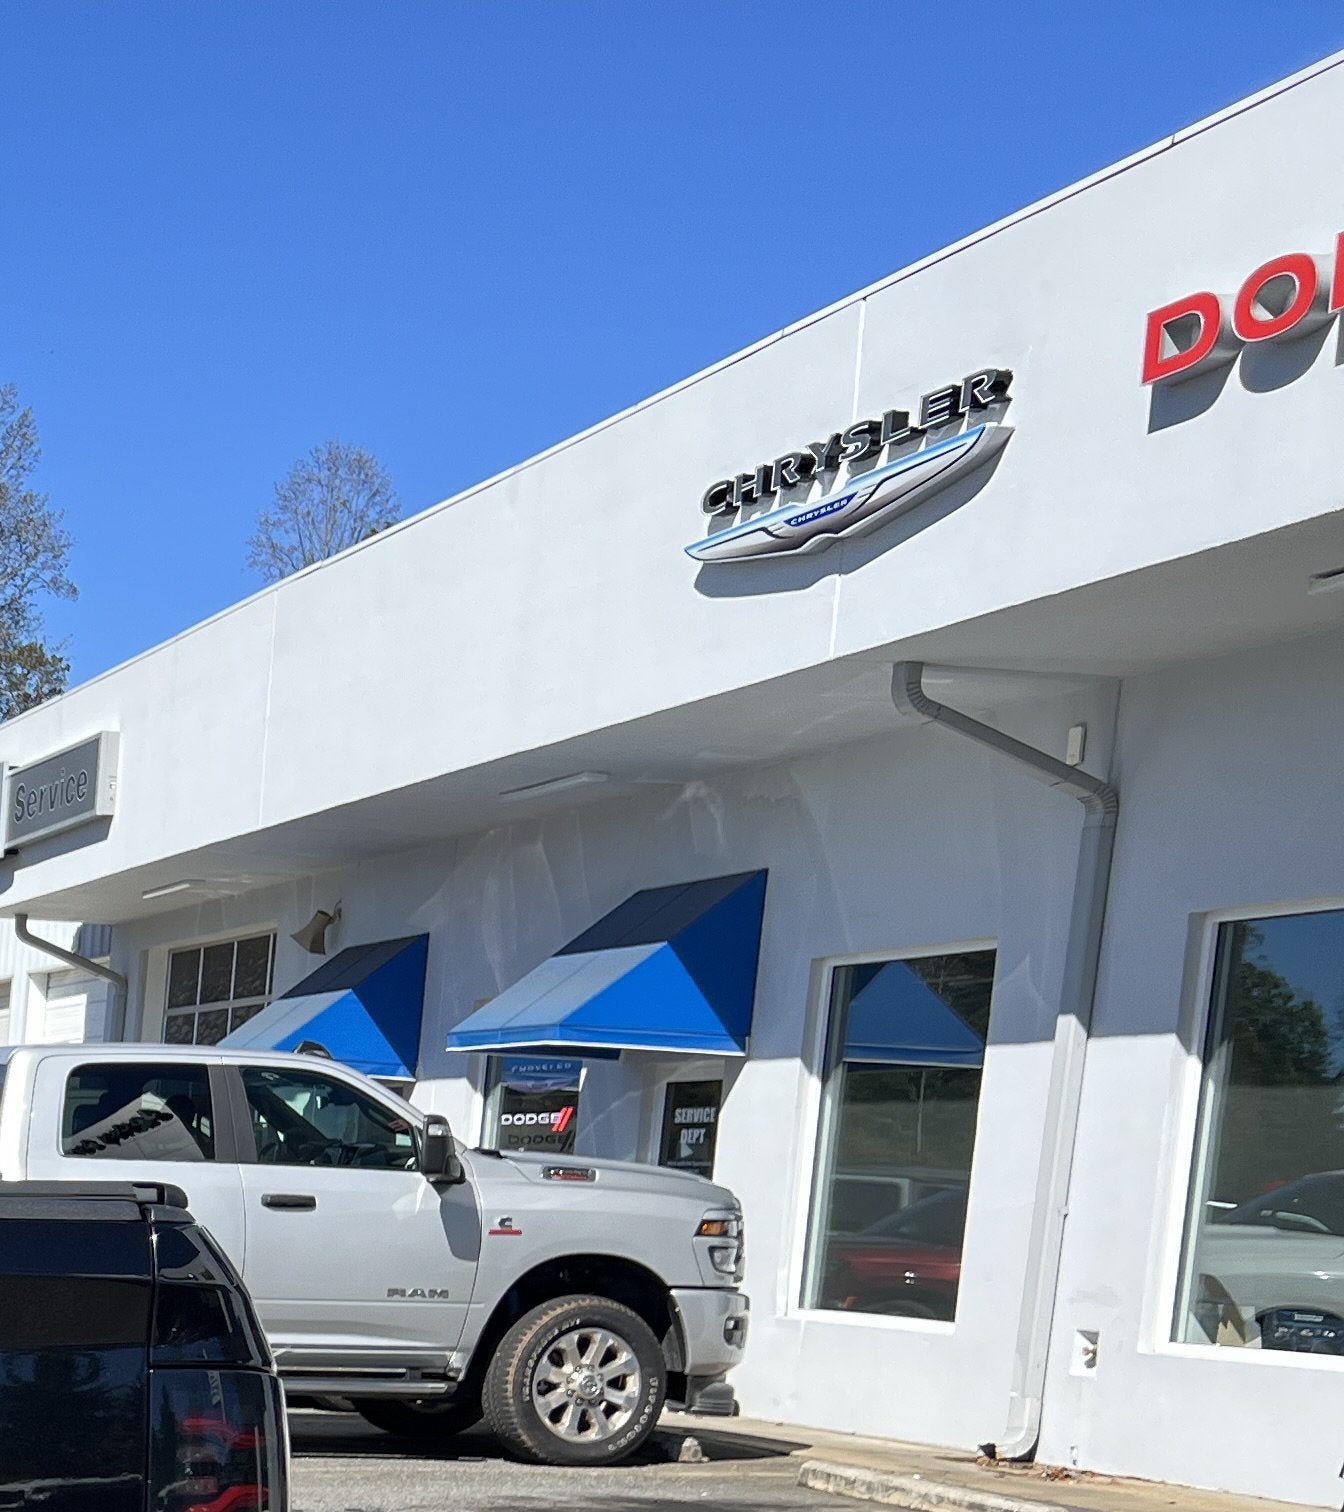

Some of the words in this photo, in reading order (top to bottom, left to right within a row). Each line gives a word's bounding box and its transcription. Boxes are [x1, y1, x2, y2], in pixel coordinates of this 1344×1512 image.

[1142, 231, 1344, 385] DO
[703, 369, 1012, 515] CHRYSLER
[790, 499, 848, 525] CHRYSLER
[14, 768, 88, 824] Service
[501, 1112, 562, 1126] DODGE
[674, 1106, 717, 1124] SERVICE
[680, 1128, 706, 1145] DEPT
[387, 1288, 449, 1299] RAM
